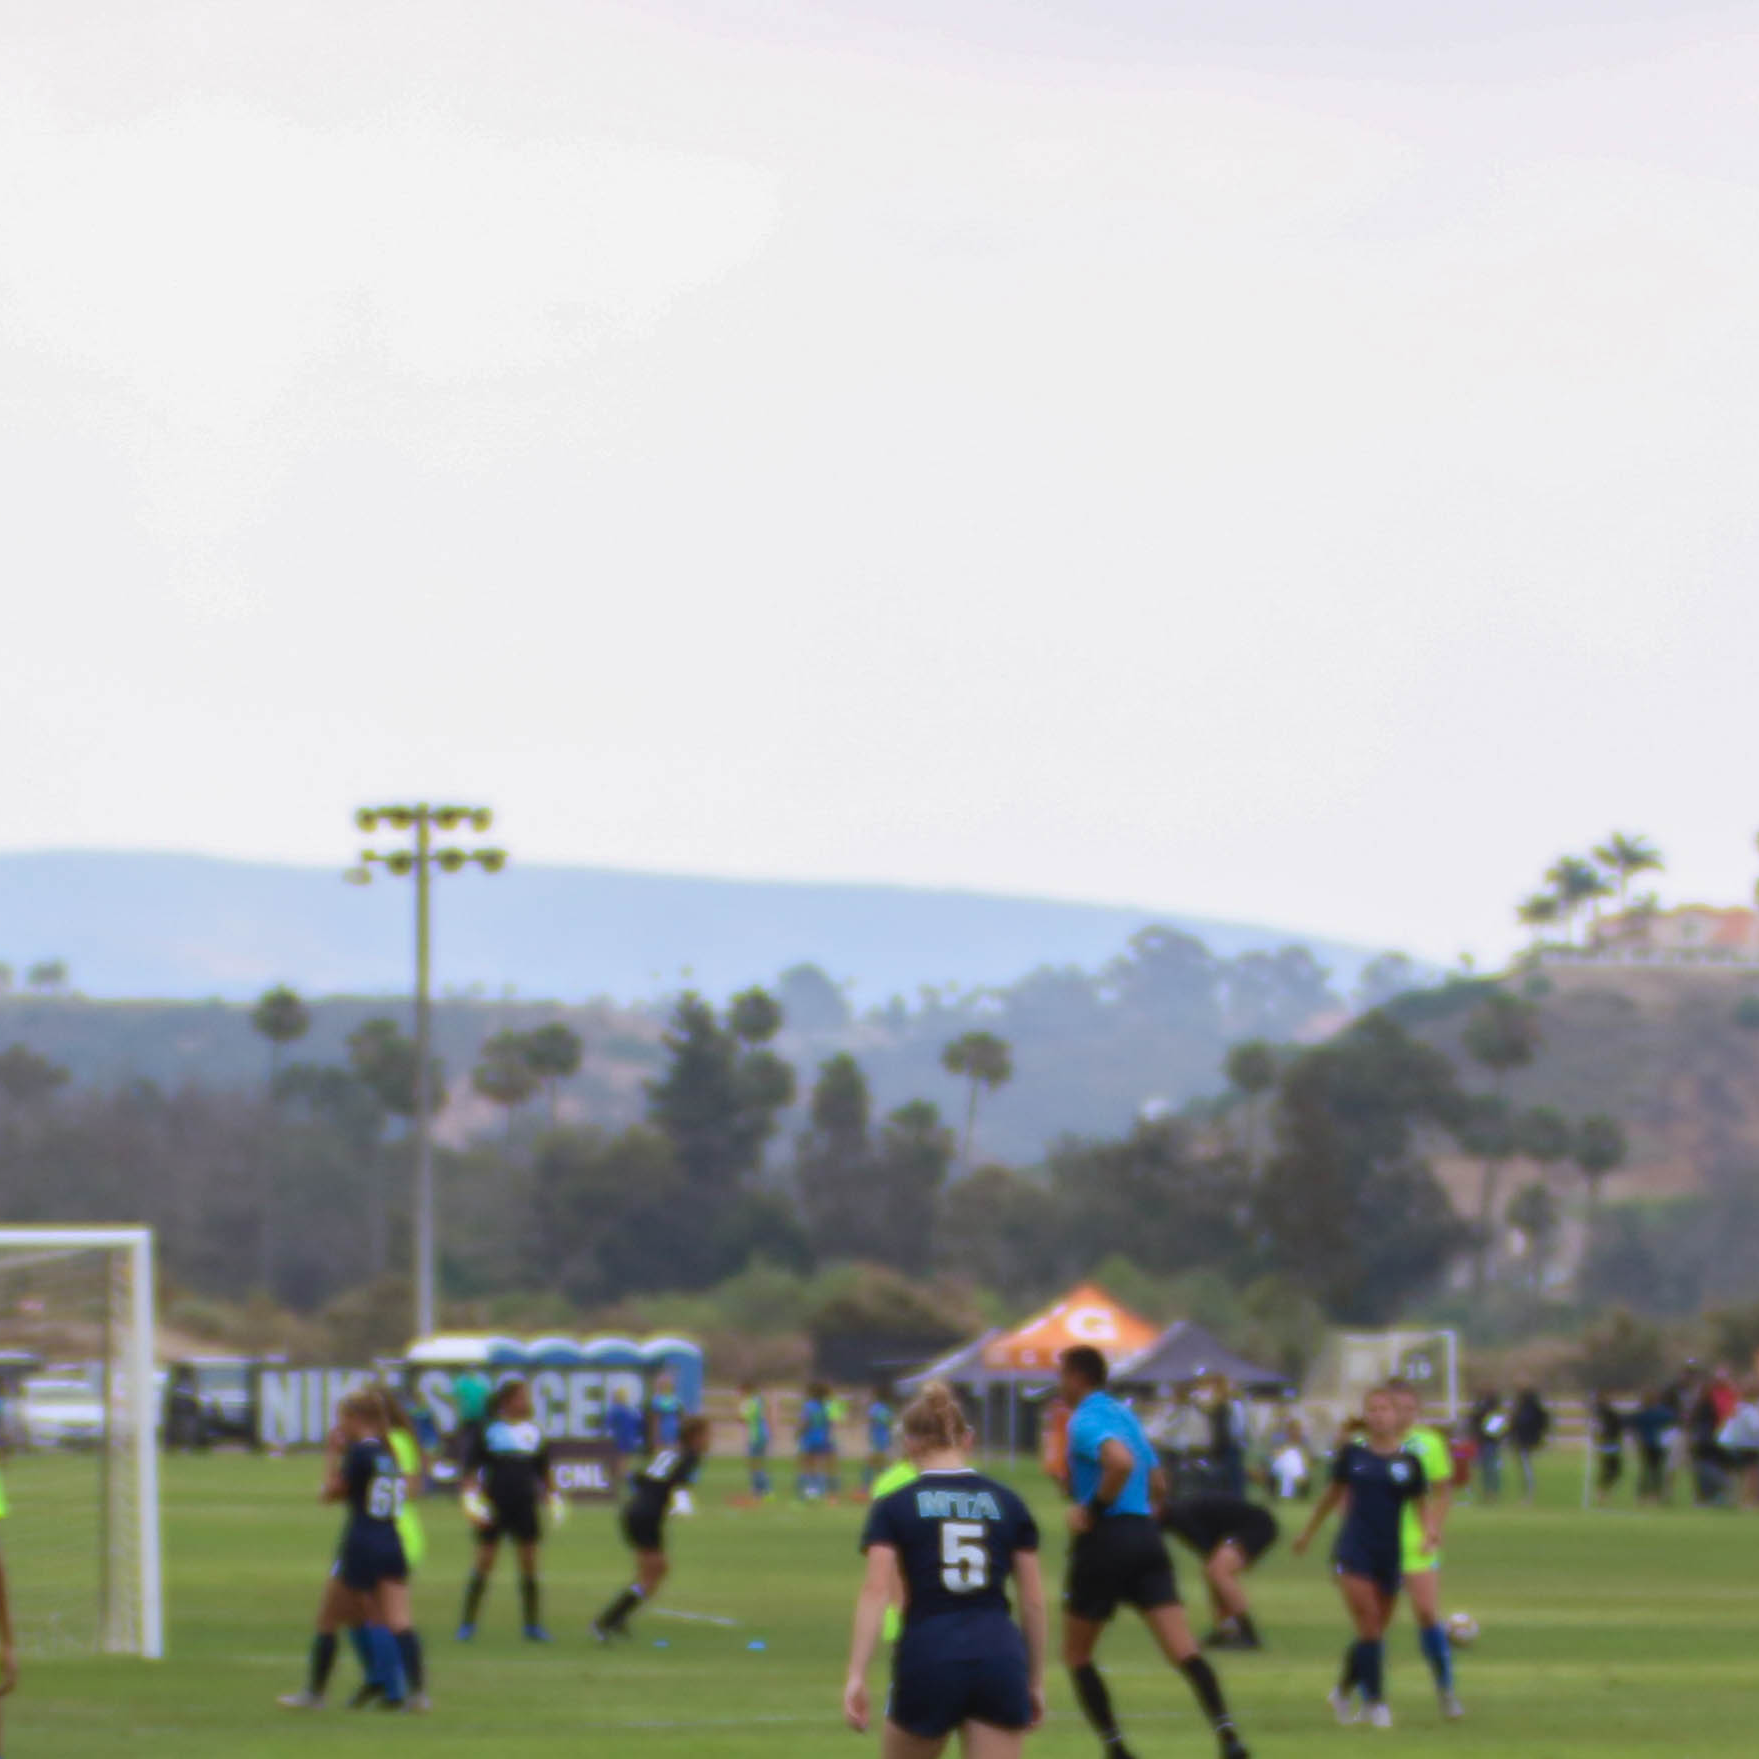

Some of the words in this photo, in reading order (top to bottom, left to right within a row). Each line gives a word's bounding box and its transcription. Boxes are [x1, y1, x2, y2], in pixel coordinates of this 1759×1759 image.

[262, 1370, 401, 1442] NIK
[418, 1370, 644, 1438] SCER
[549, 1463, 610, 1490] CNL
[942, 1522, 986, 1592] 5
